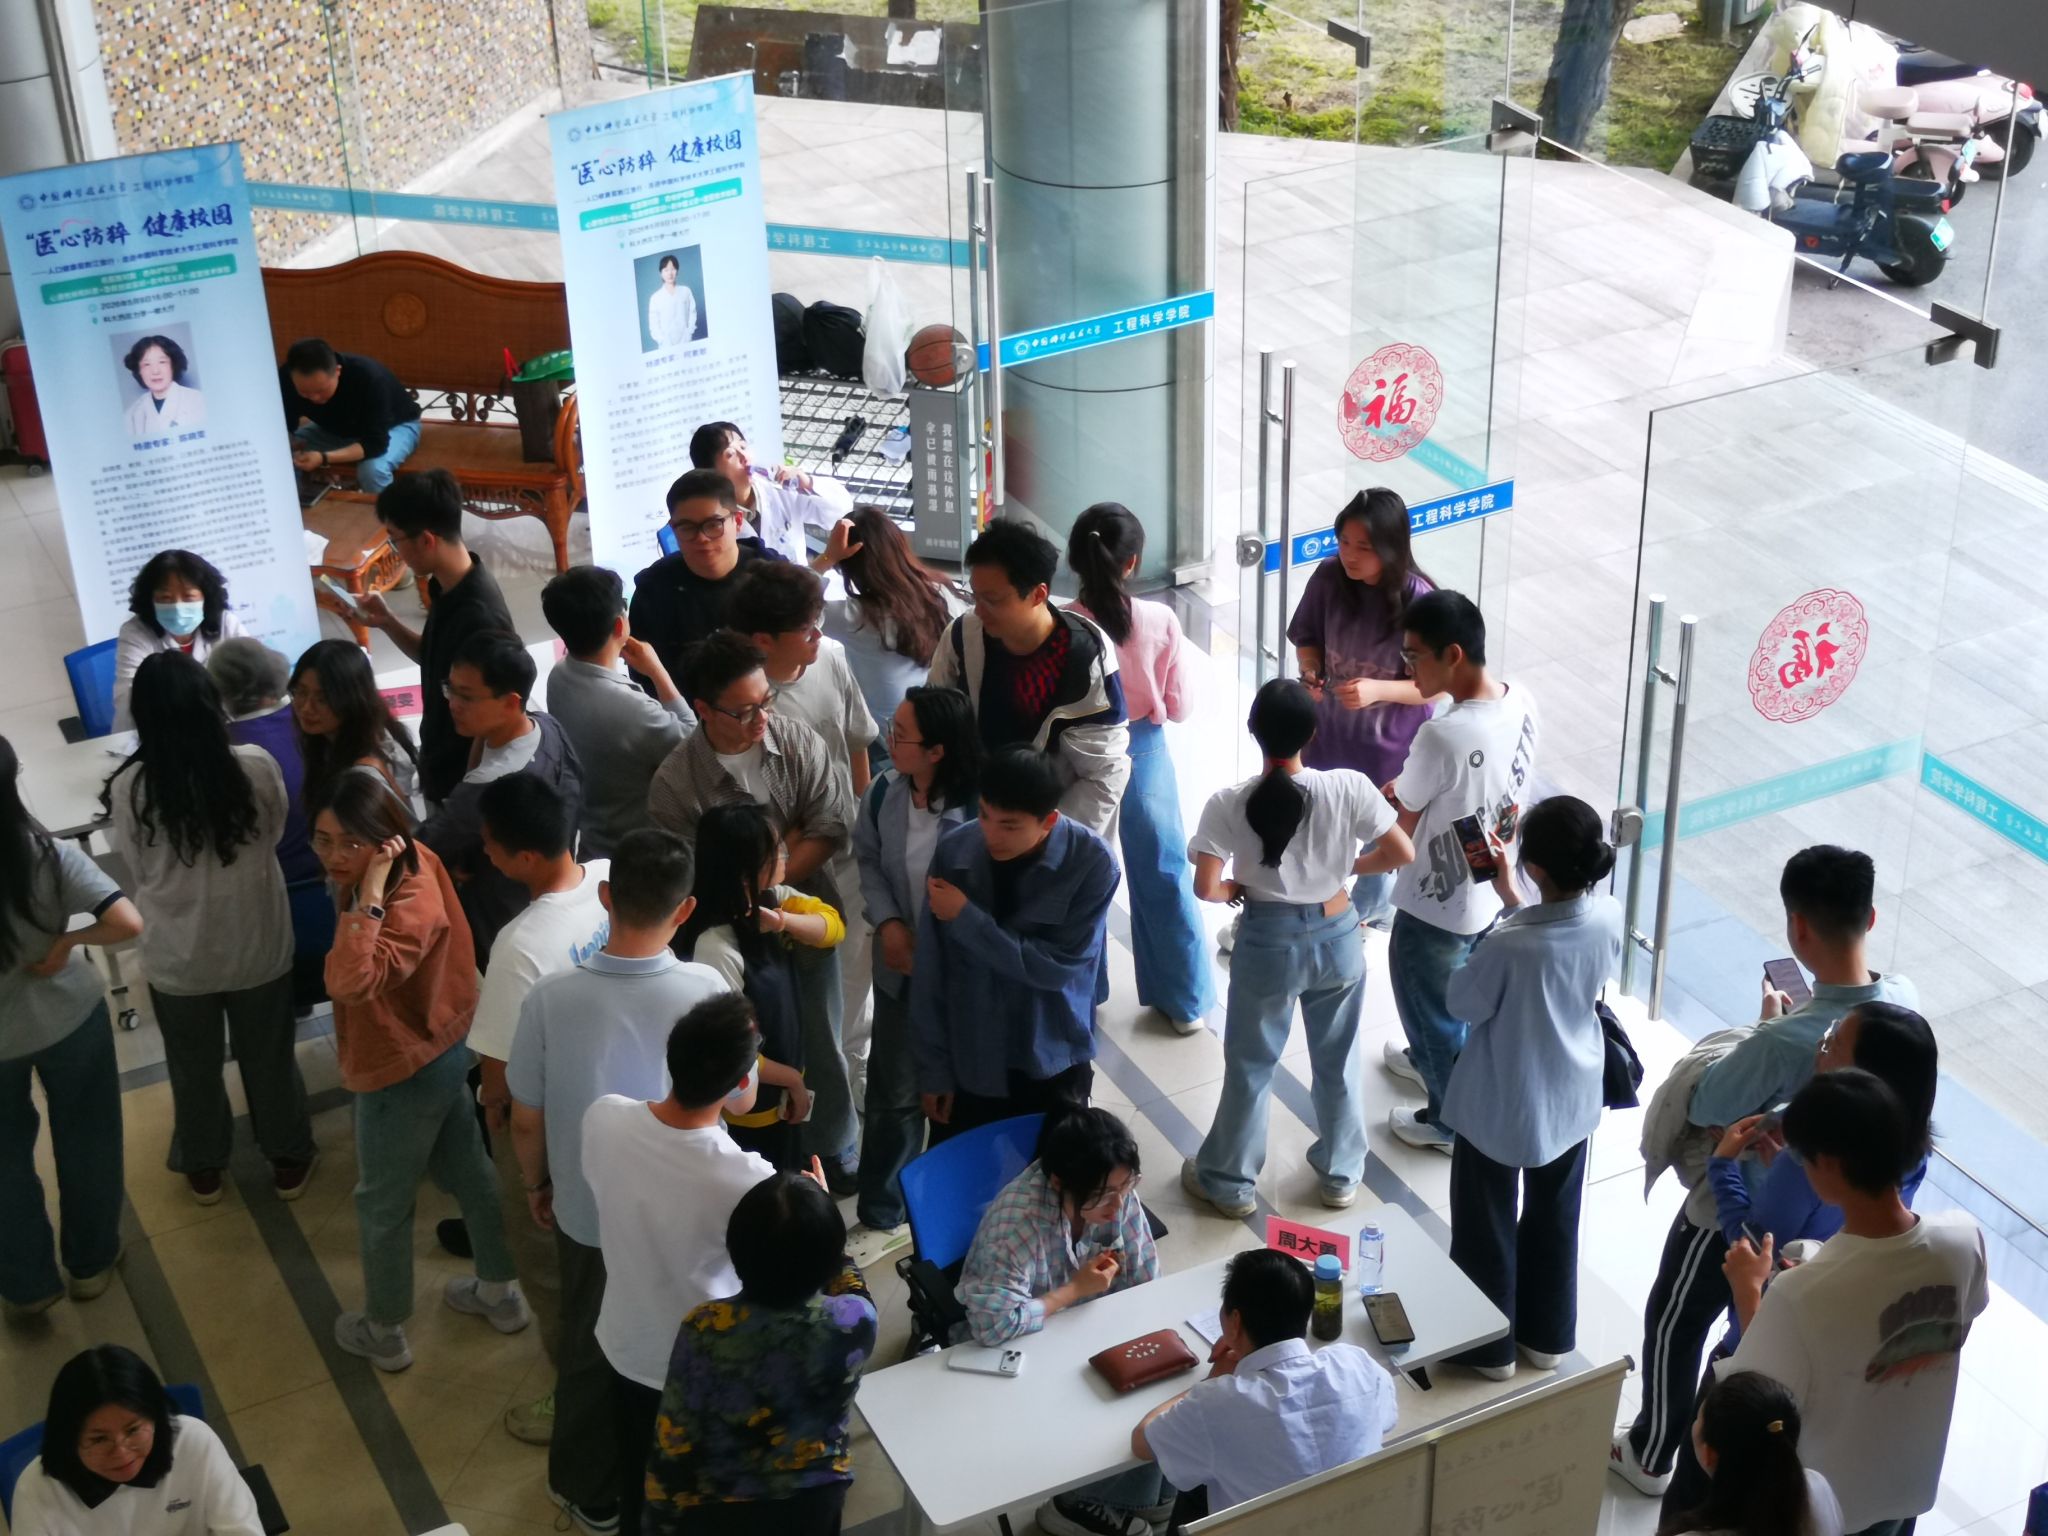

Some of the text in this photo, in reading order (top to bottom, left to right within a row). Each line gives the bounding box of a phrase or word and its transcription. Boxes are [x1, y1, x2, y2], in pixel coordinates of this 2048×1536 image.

[668, 129, 742, 163] 健康校园
[142, 203, 233, 238] 健康校园
[1113, 304, 1191, 335] 工程科学学院
[1363, 373, 1417, 429] 福
[1411, 493, 1495, 529] 工程科学学院
